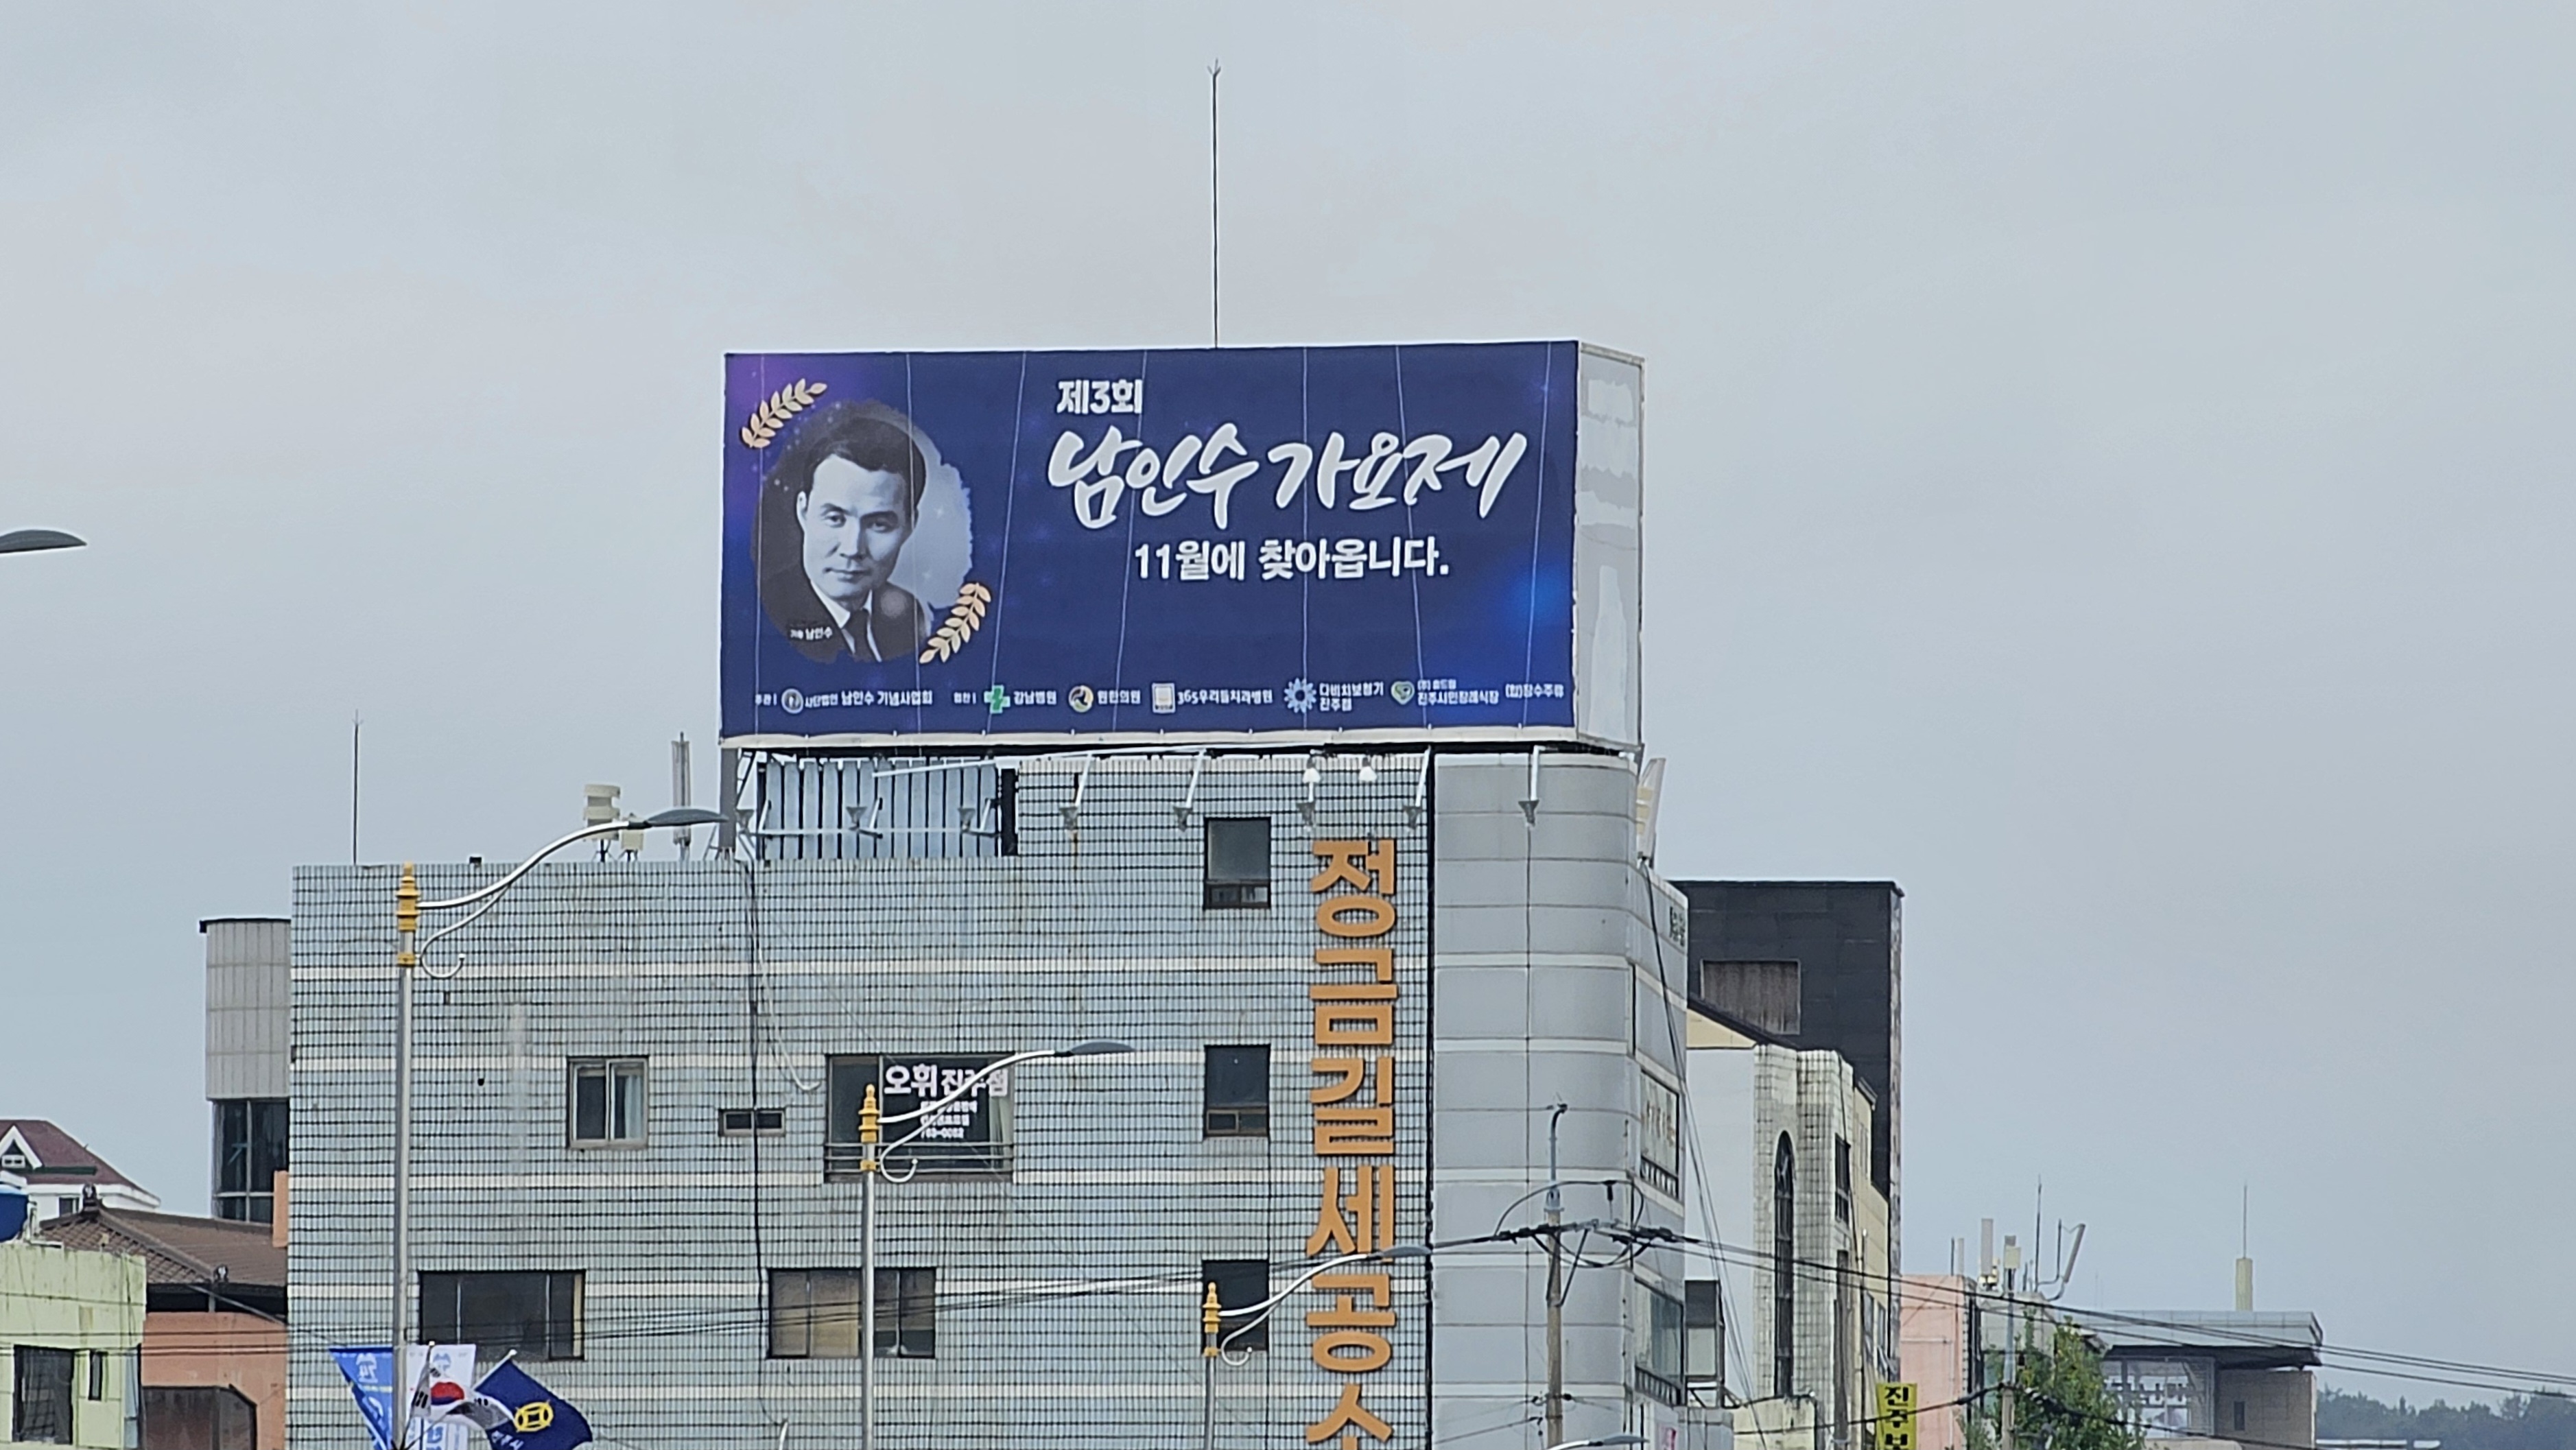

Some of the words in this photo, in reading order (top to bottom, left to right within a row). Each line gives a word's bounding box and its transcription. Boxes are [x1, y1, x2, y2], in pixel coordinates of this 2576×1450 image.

[1056, 379, 1143, 414] 제3회
[1048, 422, 1260, 530] 남인수
[1267, 431, 1528, 518] 가요제
[1135, 539, 1245, 580] 11월에
[1258, 536, 1449, 580] 찾아옵니다.
[841, 690, 875, 706] 남인수
[877, 689, 934, 706] 기념사업회
[884, 1063, 937, 1097] 오휘
